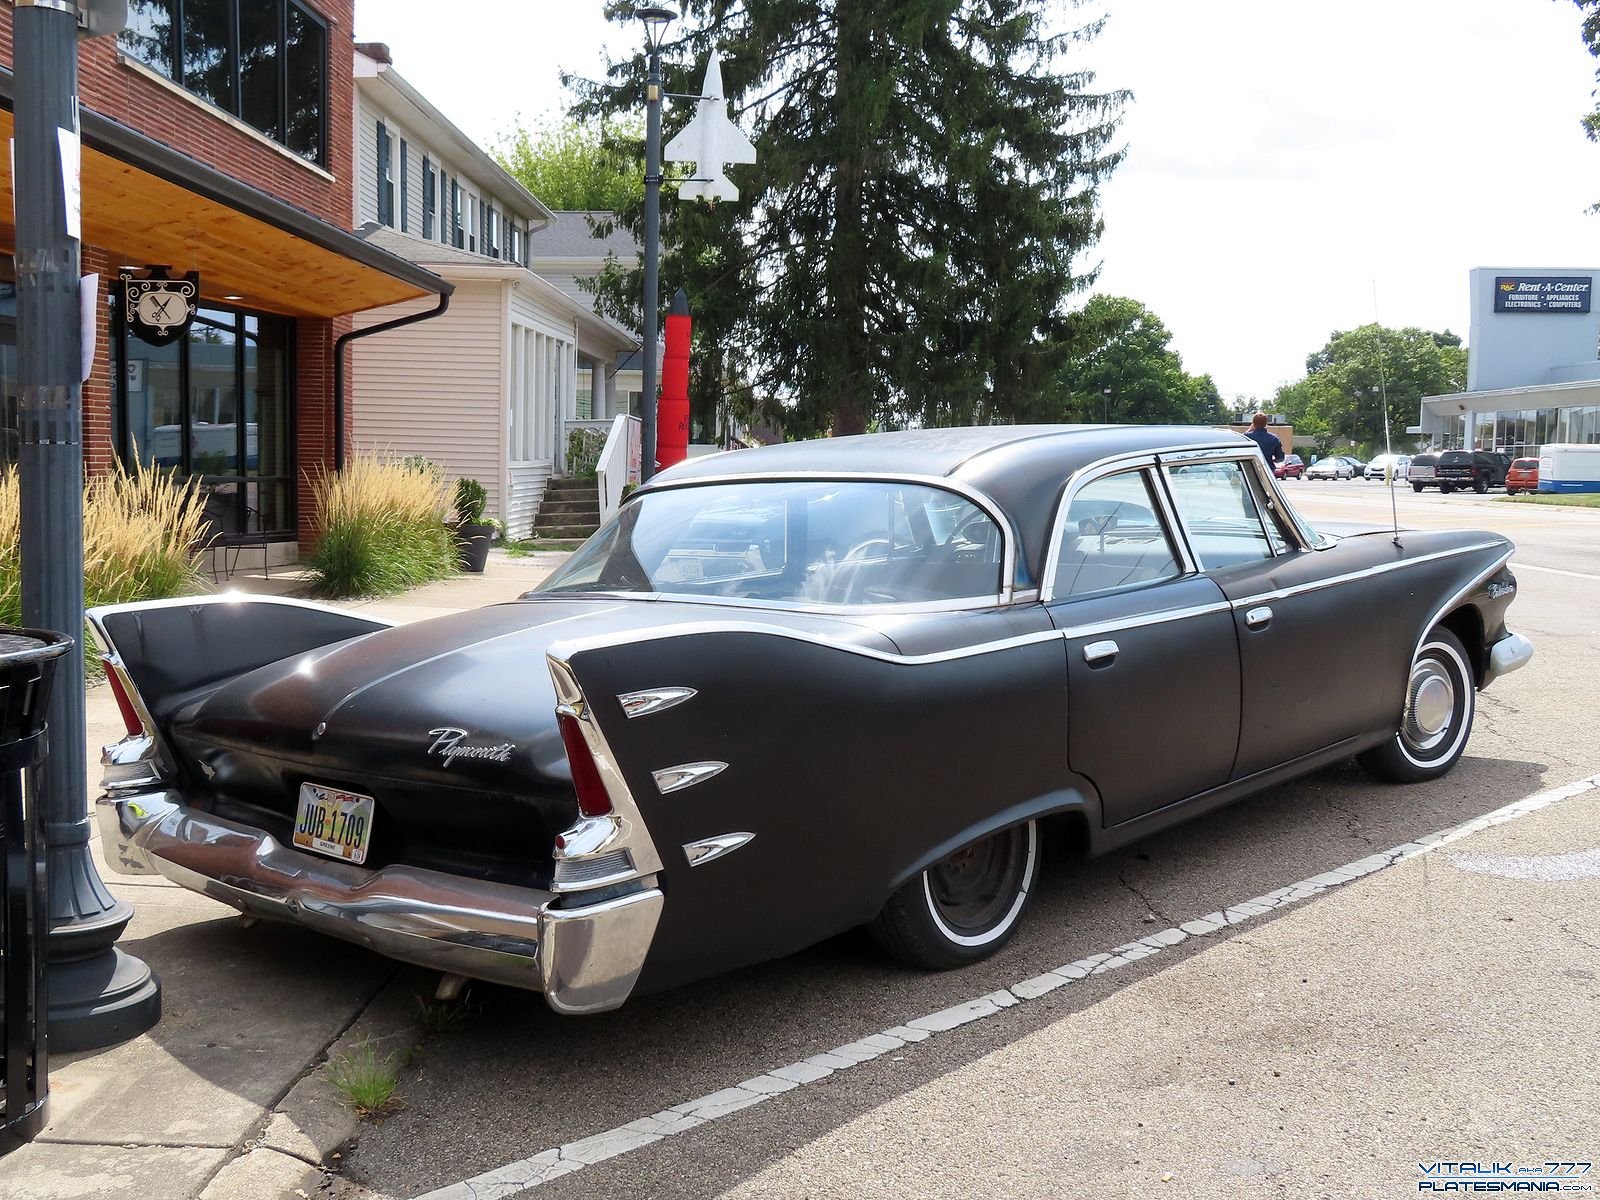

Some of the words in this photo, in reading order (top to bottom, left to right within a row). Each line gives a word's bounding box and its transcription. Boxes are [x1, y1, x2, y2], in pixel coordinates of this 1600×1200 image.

[427, 726, 516, 768] Plymouth
[300, 803, 326, 838] JUB
[328, 809, 365, 849] 1709
